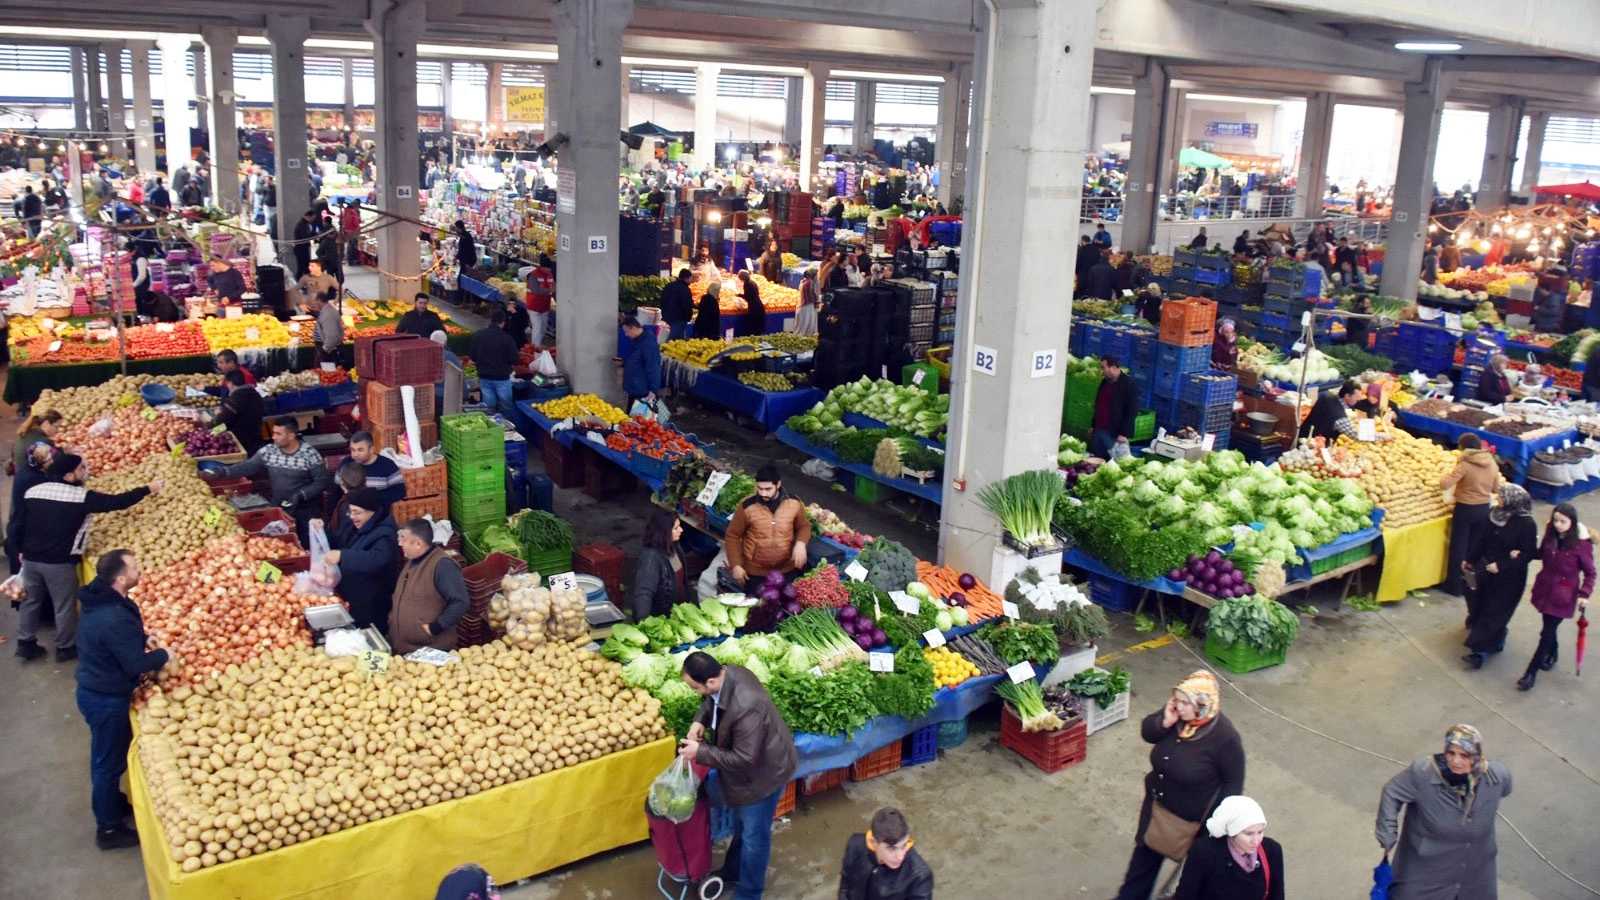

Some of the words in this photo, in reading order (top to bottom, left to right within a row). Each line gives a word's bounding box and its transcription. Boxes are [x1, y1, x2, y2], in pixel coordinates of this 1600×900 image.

[508, 93, 536, 107] YILMAZ
[398, 188, 409, 196] B4
[590, 239, 605, 250] B3
[976, 351, 994, 371] B2
[1035, 354, 1053, 371] B2
[564, 580, 571, 590] 5
[364, 651, 372, 661] 3
[369, 660, 379, 670] 5
